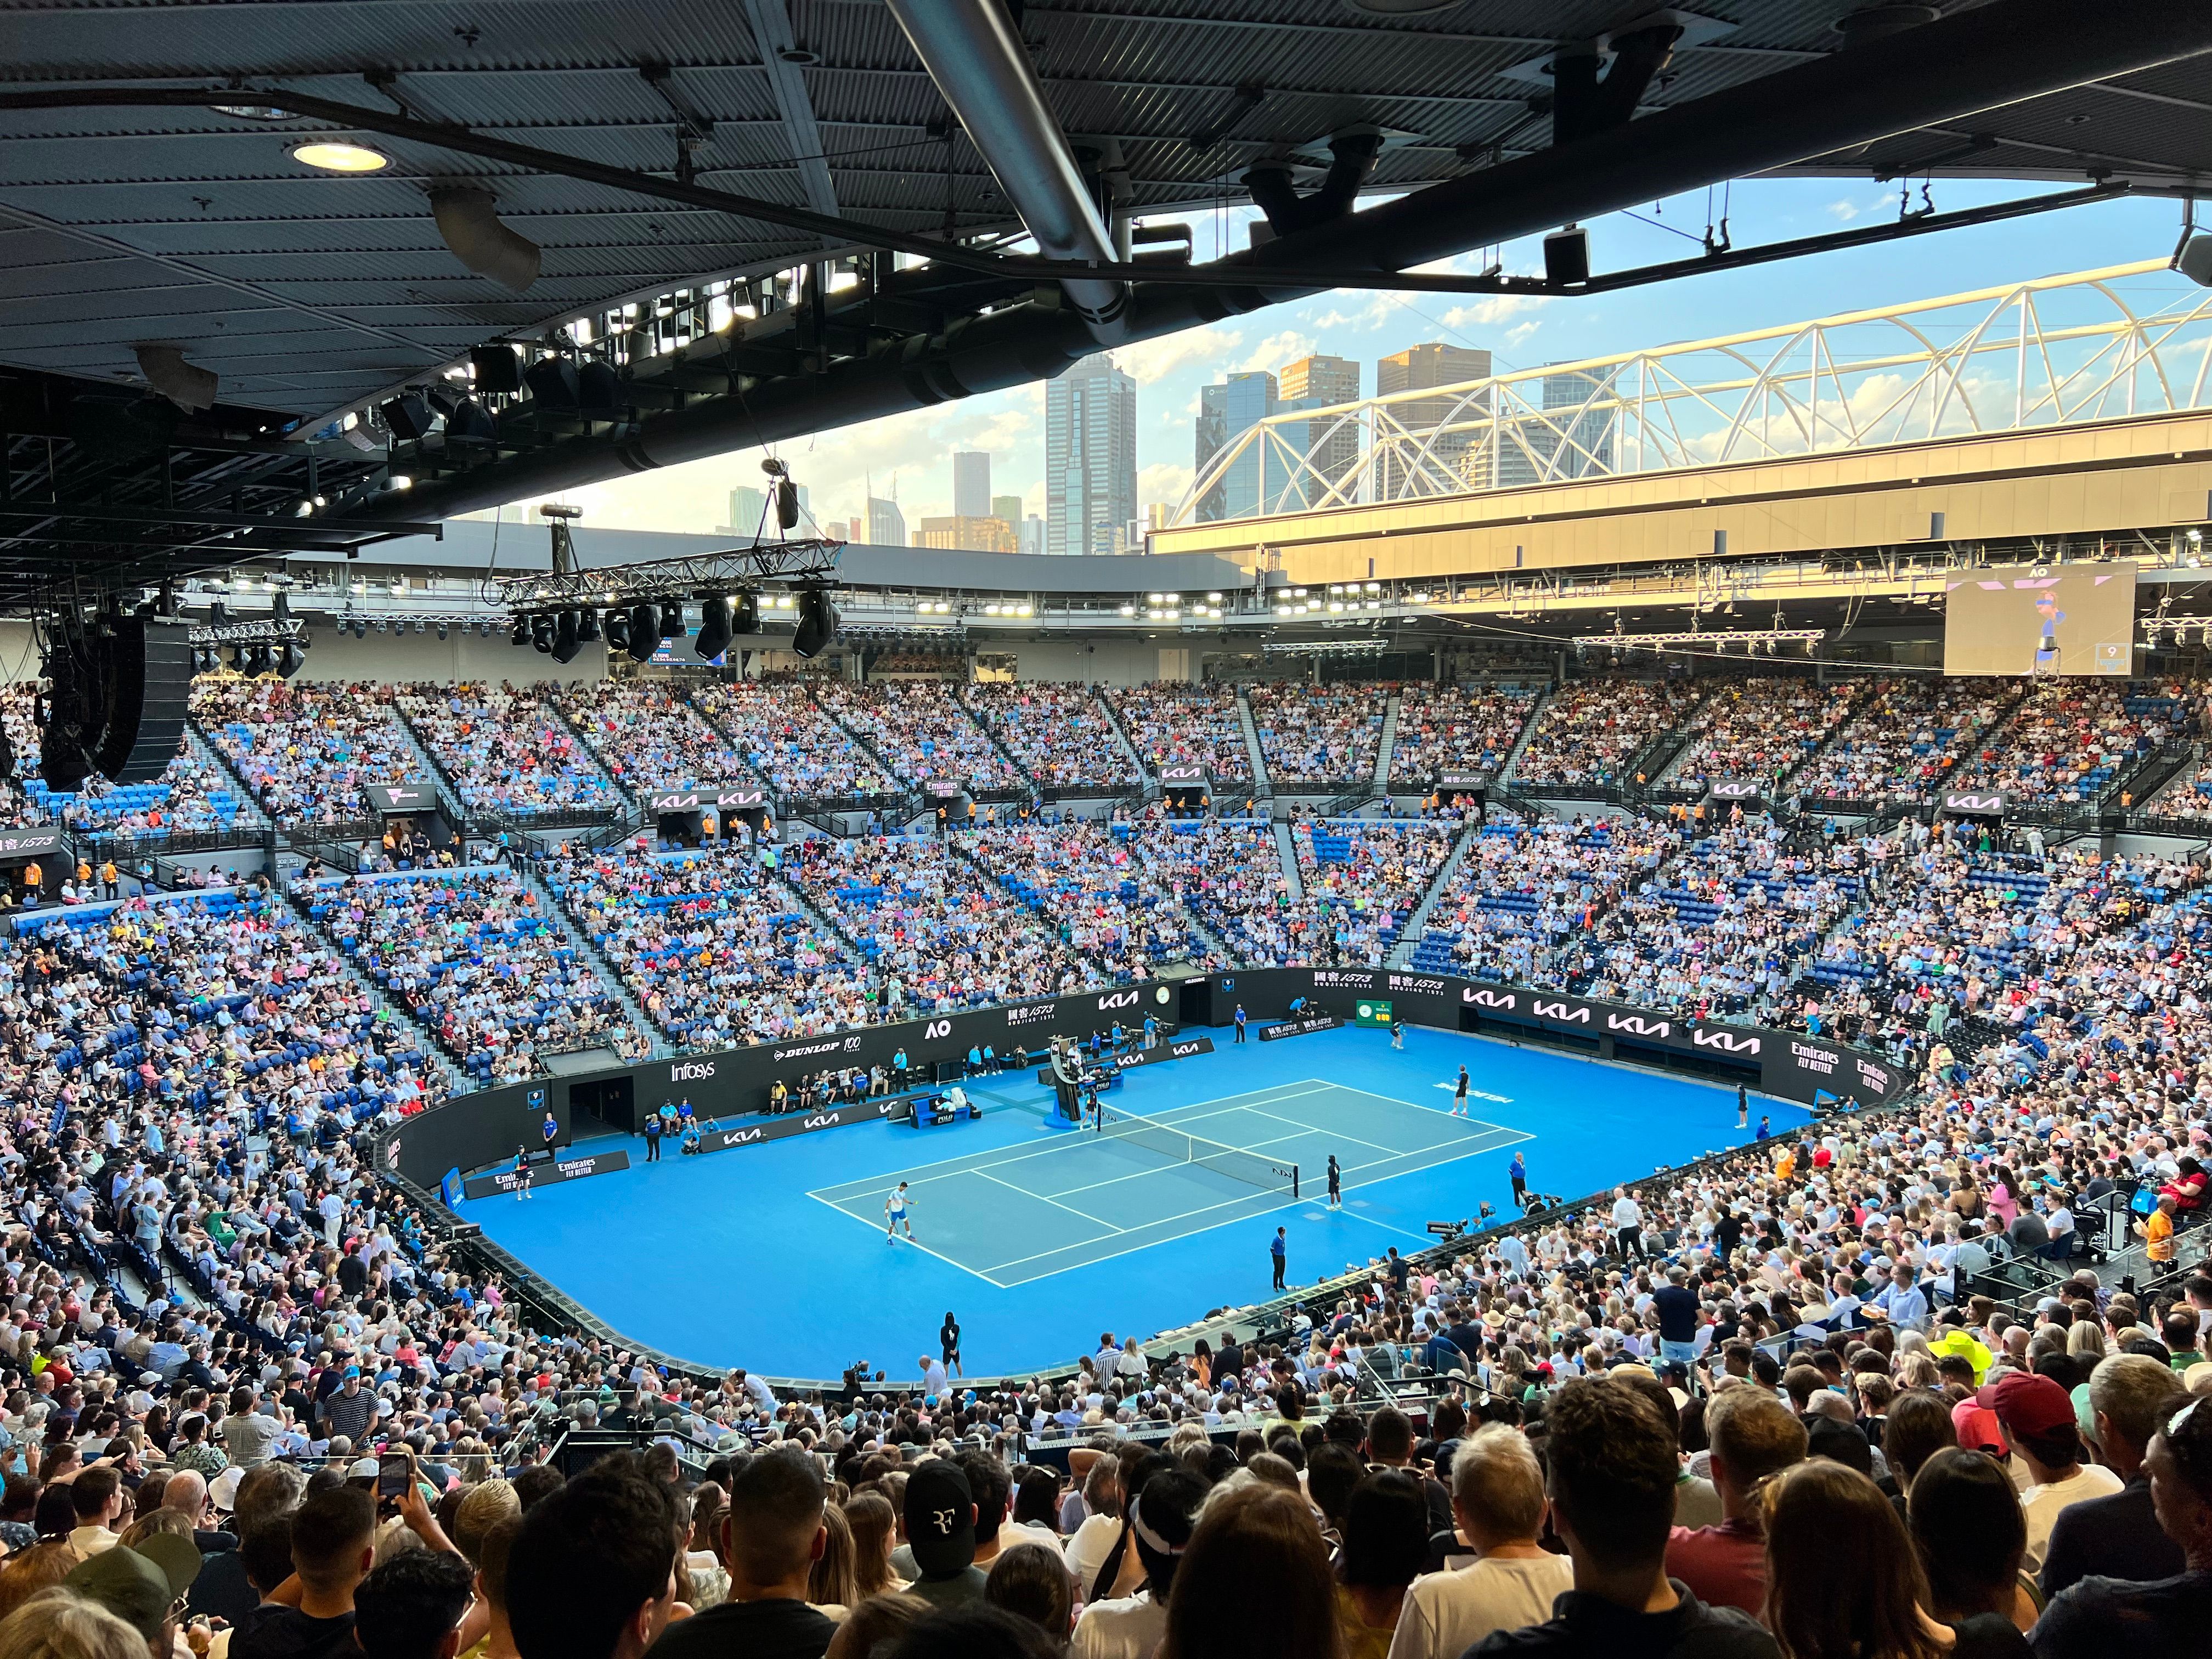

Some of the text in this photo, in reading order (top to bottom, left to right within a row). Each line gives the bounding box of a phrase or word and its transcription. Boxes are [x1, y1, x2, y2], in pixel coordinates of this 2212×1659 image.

[2108, 646, 2117, 657] 9
[1162, 768, 1200, 778] KIA
[927, 781, 958, 790] Emirates
[1713, 783, 1757, 795] KIA
[652, 794, 697, 809] KIA
[718, 791, 761, 805] KIA
[1947, 794, 2000, 809] KIA
[20, 836, 55, 849] 1573
[1340, 973, 1373, 983] 1573
[1414, 979, 1444, 990] 1573
[1099, 990, 1138, 1010] KIA
[1463, 988, 1515, 1009] KIA
[1029, 1003, 1055, 1017] 1573
[1533, 1000, 1590, 1024] KIA
[924, 1019, 951, 1039] AO
[1282, 1024, 1297, 1032] 1573
[1609, 1013, 1669, 1038] KIA
[785, 1036, 861, 1058] DUNLOP 100
[1694, 1028, 1760, 1054] KIA
[1173, 1043, 1199, 1055] KIA
[1791, 1041, 1839, 1065] Emirates
[1117, 1053, 1144, 1065] KIA
[1798, 1057, 1832, 1075] FLY BETTER
[672, 1062, 714, 1081] Infosys
[1857, 1058, 1887, 1084] Emirates
[533, 1092, 539, 1100] 9
[804, 1113, 839, 1128] KIA
[938, 1114, 953, 1122] POLO
[723, 1128, 761, 1144] KIA
[558, 1158, 596, 1172] Emirates
[566, 1166, 592, 1178] FLY BETTER
